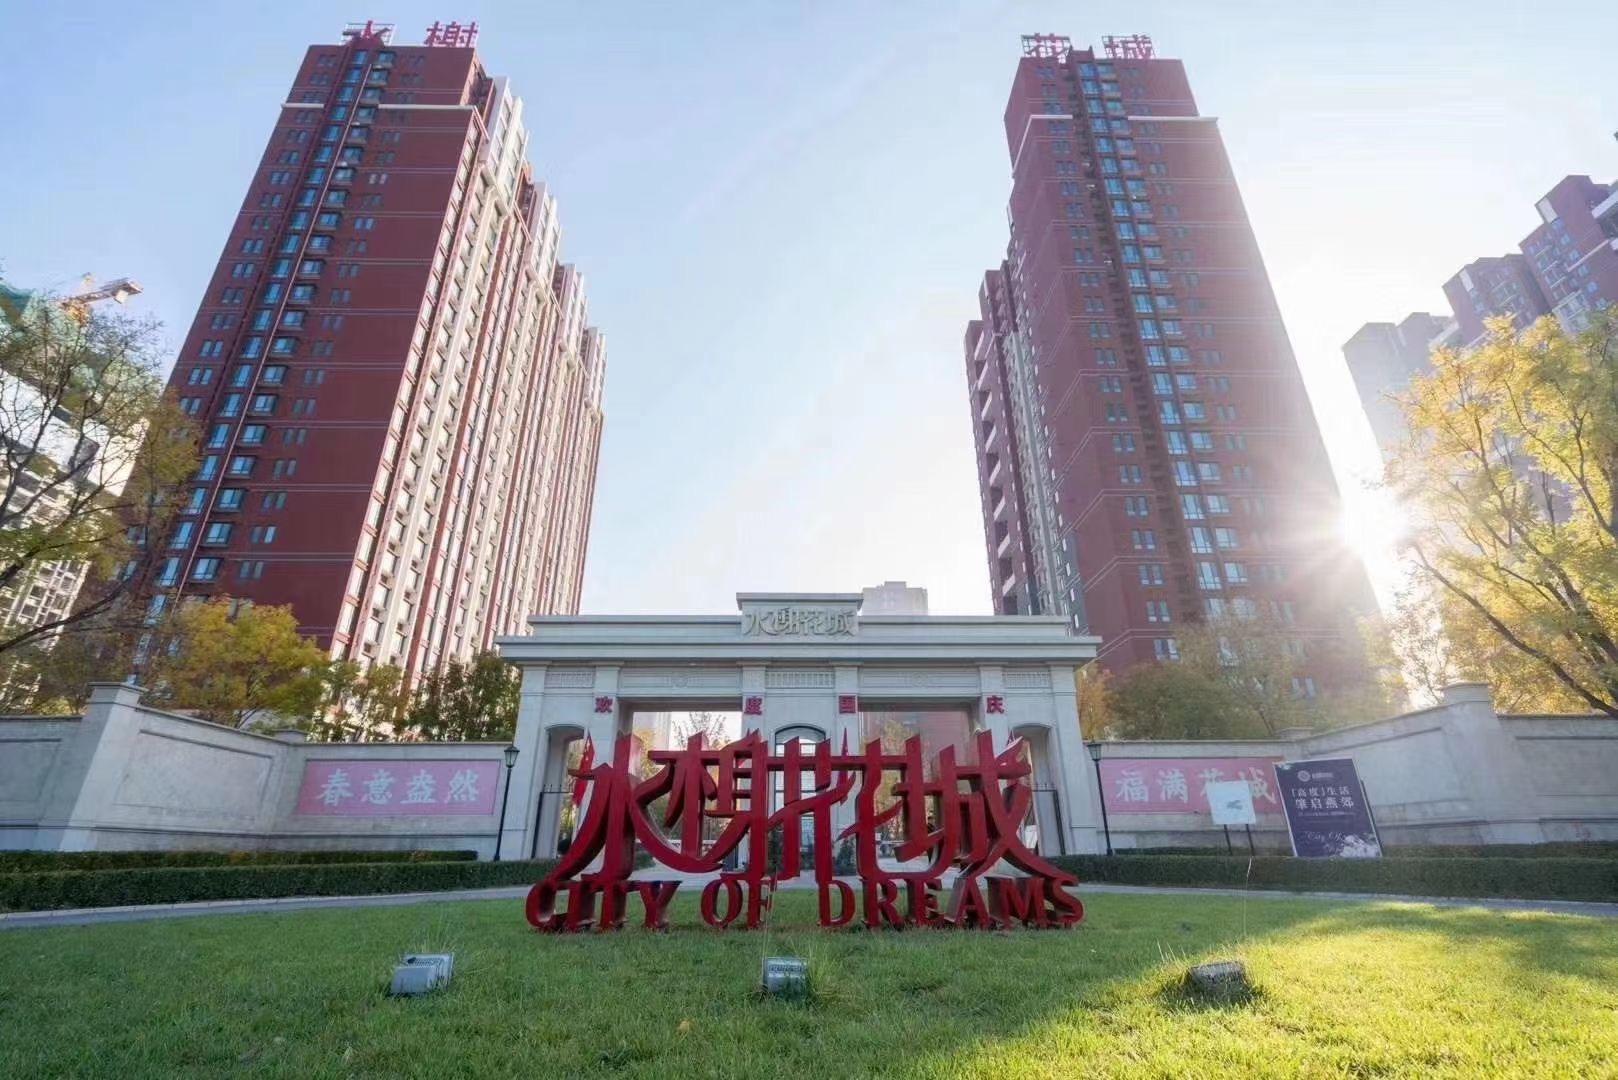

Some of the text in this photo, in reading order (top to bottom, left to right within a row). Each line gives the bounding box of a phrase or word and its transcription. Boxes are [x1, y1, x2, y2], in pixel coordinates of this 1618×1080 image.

[743, 607, 857, 637] 水榭花城
[315, 767, 480, 807] 春意盎然
[543, 728, 1079, 886] 水榭花城
[525, 876, 1086, 932] CITY OF DREAMS
